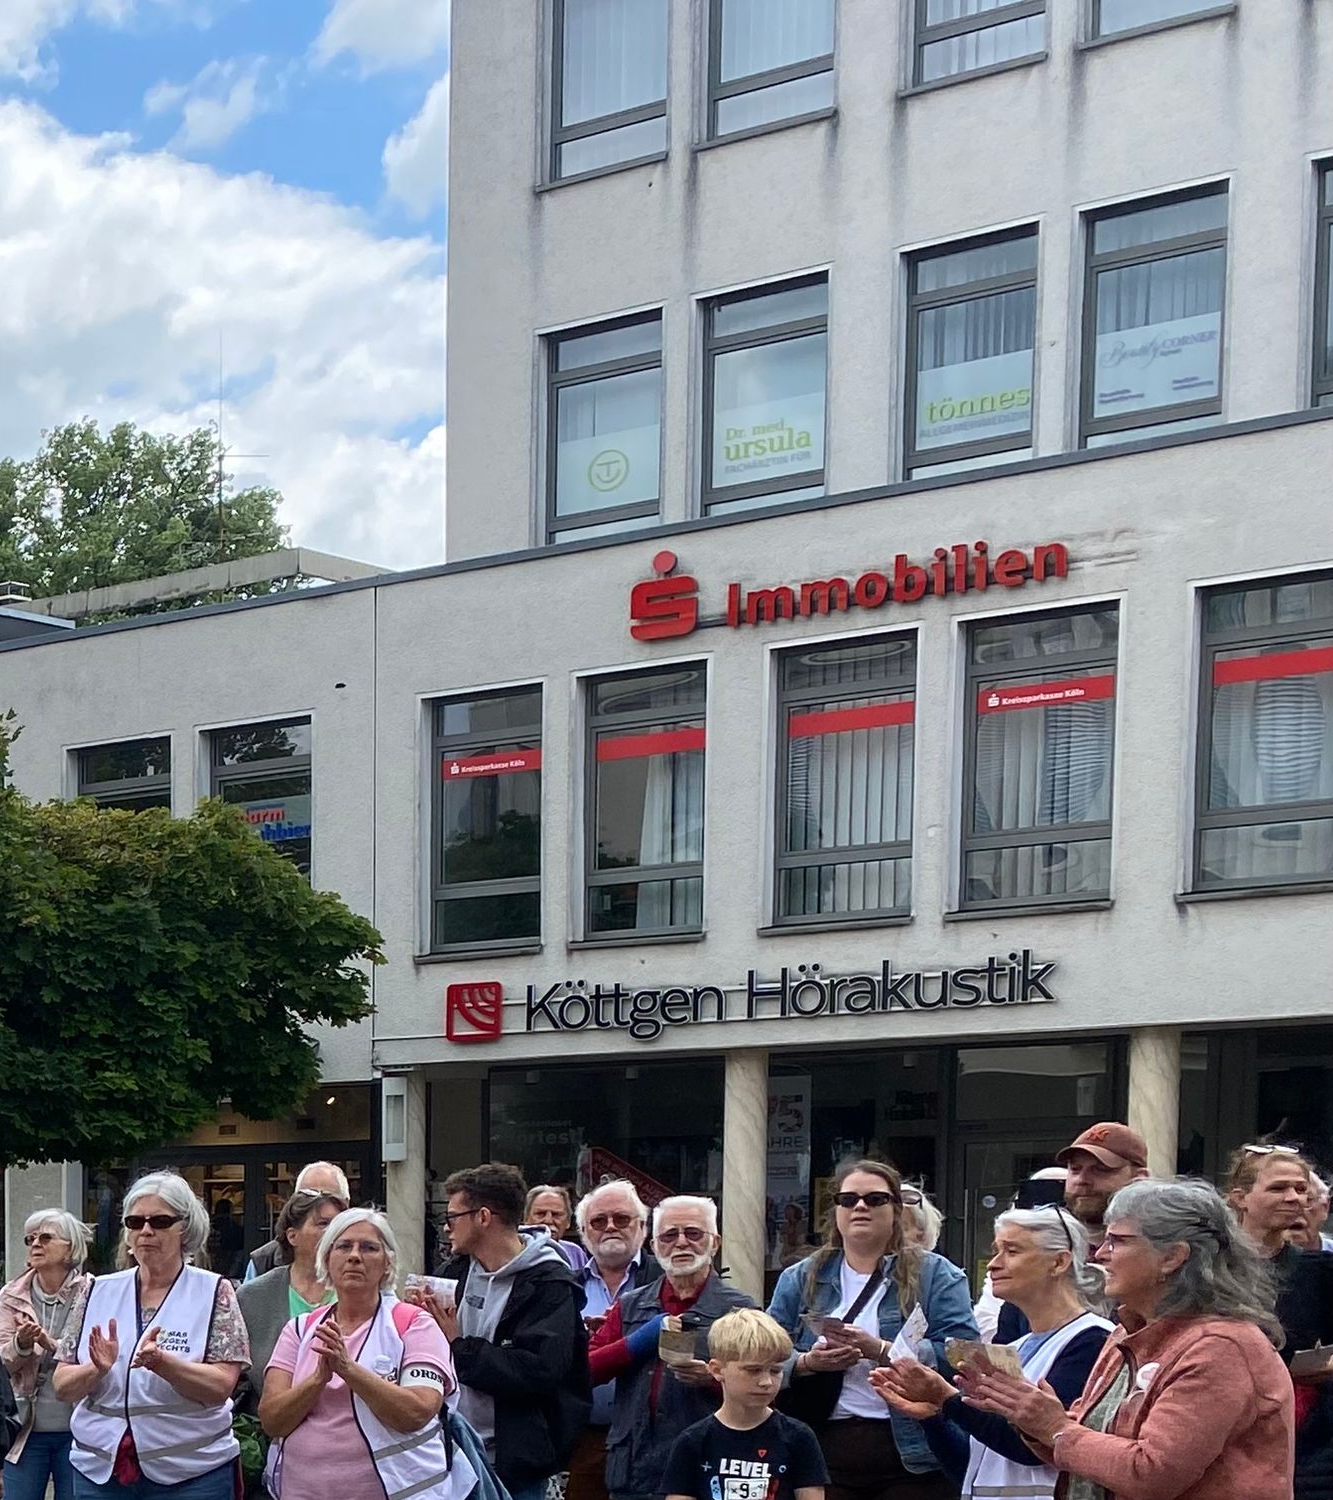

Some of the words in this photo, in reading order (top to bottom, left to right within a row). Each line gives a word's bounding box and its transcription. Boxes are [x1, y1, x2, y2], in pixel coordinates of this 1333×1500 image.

[925, 386, 1031, 425] tönnes
[724, 427, 812, 461] ursula
[725, 426, 745, 441] Dr.
[726, 540, 1069, 628] Immobilien
[1001, 690, 1064, 706] Kreissparkasse
[1064, 688, 1085, 698] Köln
[461, 762, 509, 773] Kreissparkasse
[525, 978, 726, 1041] Köttgen
[747, 949, 1058, 1018] Hörakustik
[719, 1458, 772, 1478] LEVEL
